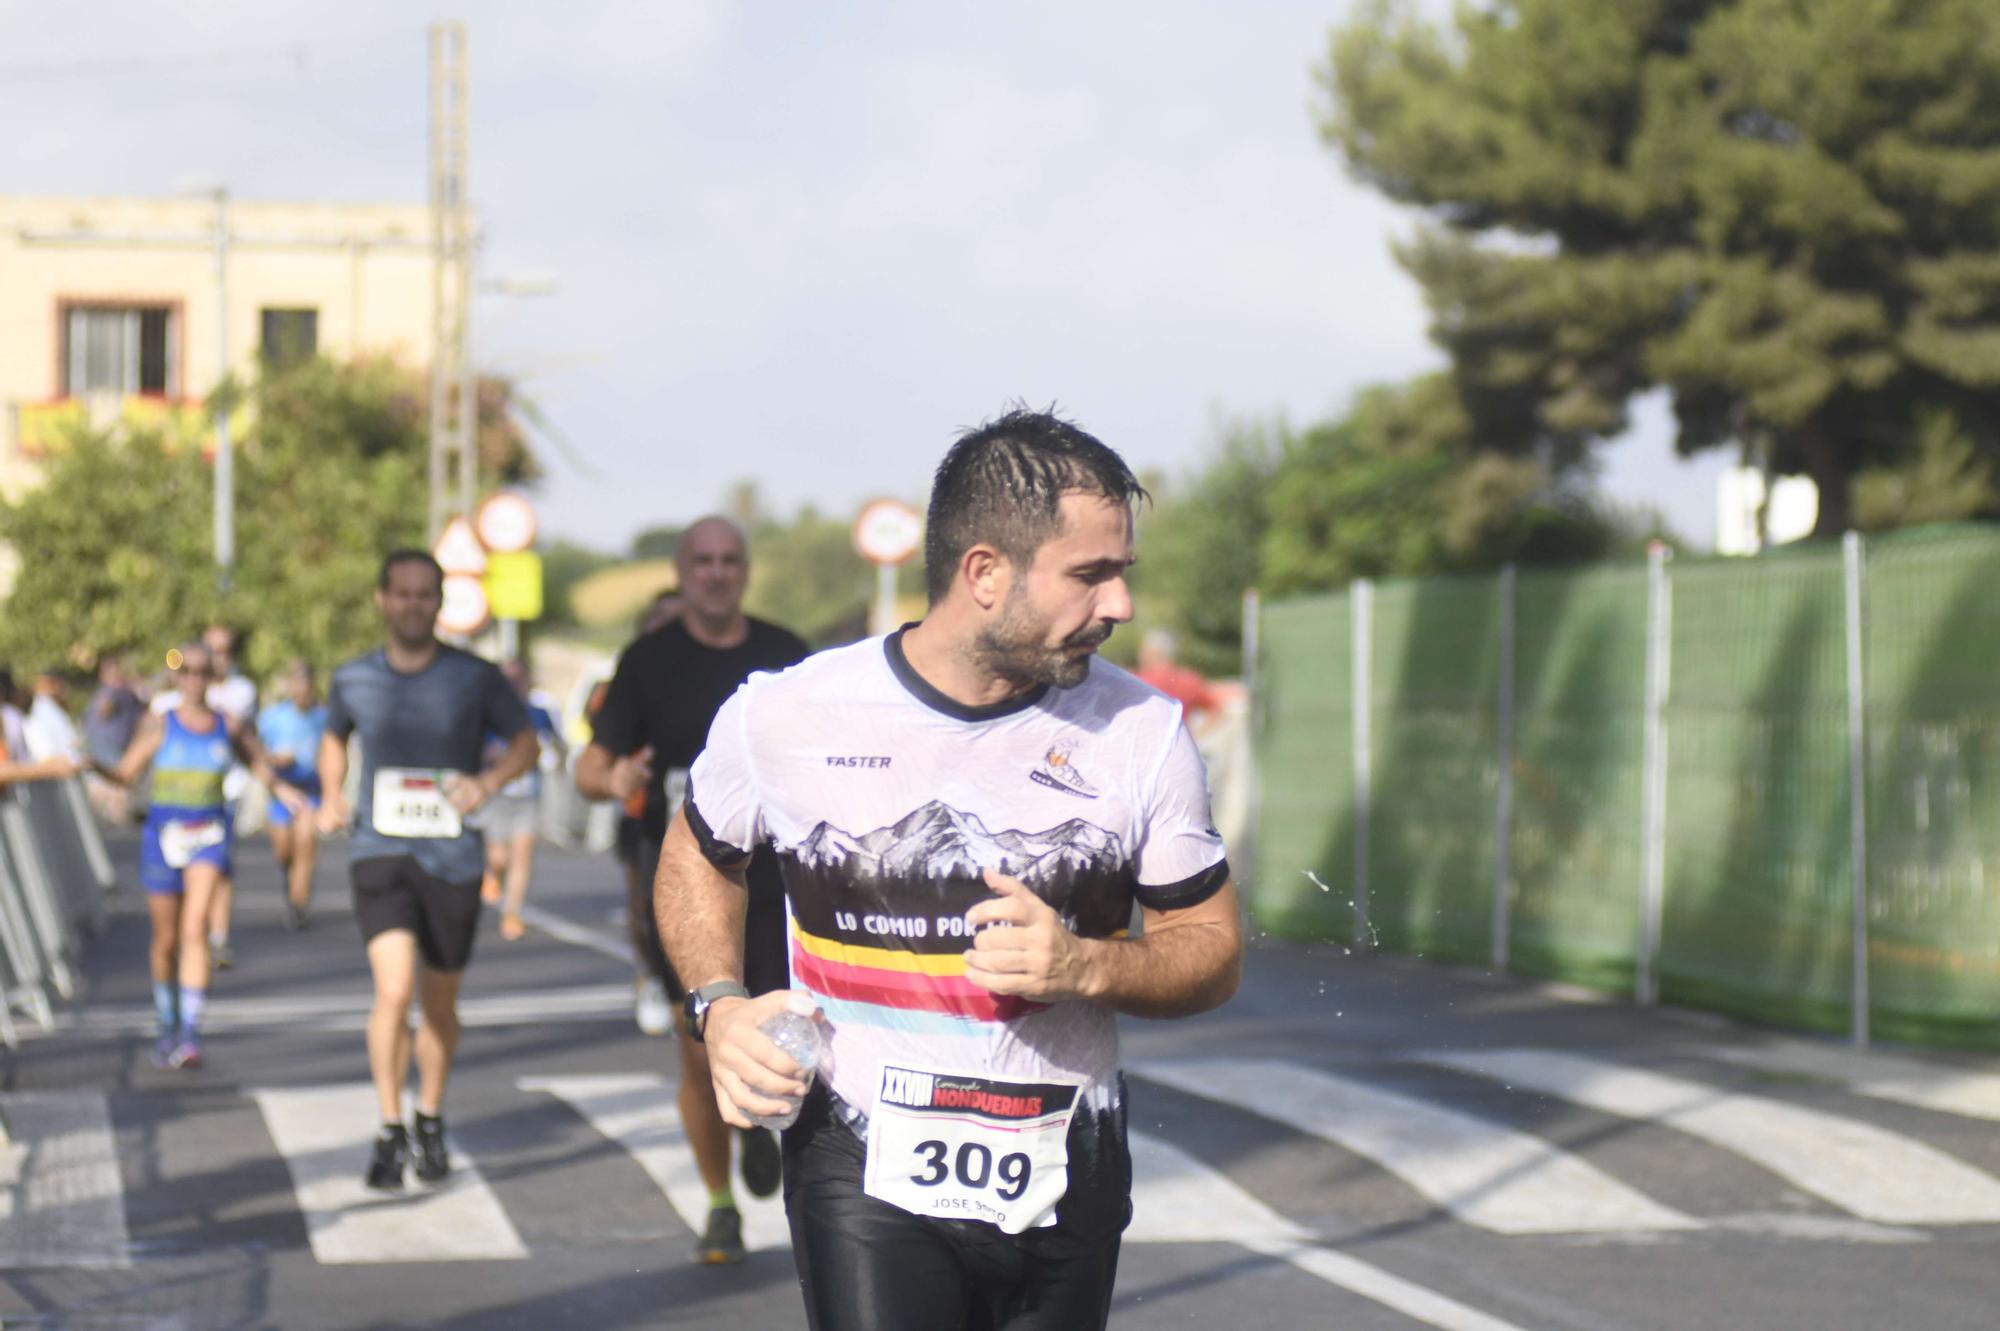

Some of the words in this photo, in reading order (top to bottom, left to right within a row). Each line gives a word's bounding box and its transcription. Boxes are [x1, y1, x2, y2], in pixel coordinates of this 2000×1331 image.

[826, 756, 892, 768] FASTER
[835, 911, 857, 931] LO
[863, 915, 927, 938] COMIO
[910, 1140, 1031, 1201] 309
[932, 1198, 968, 1208] JOSE
